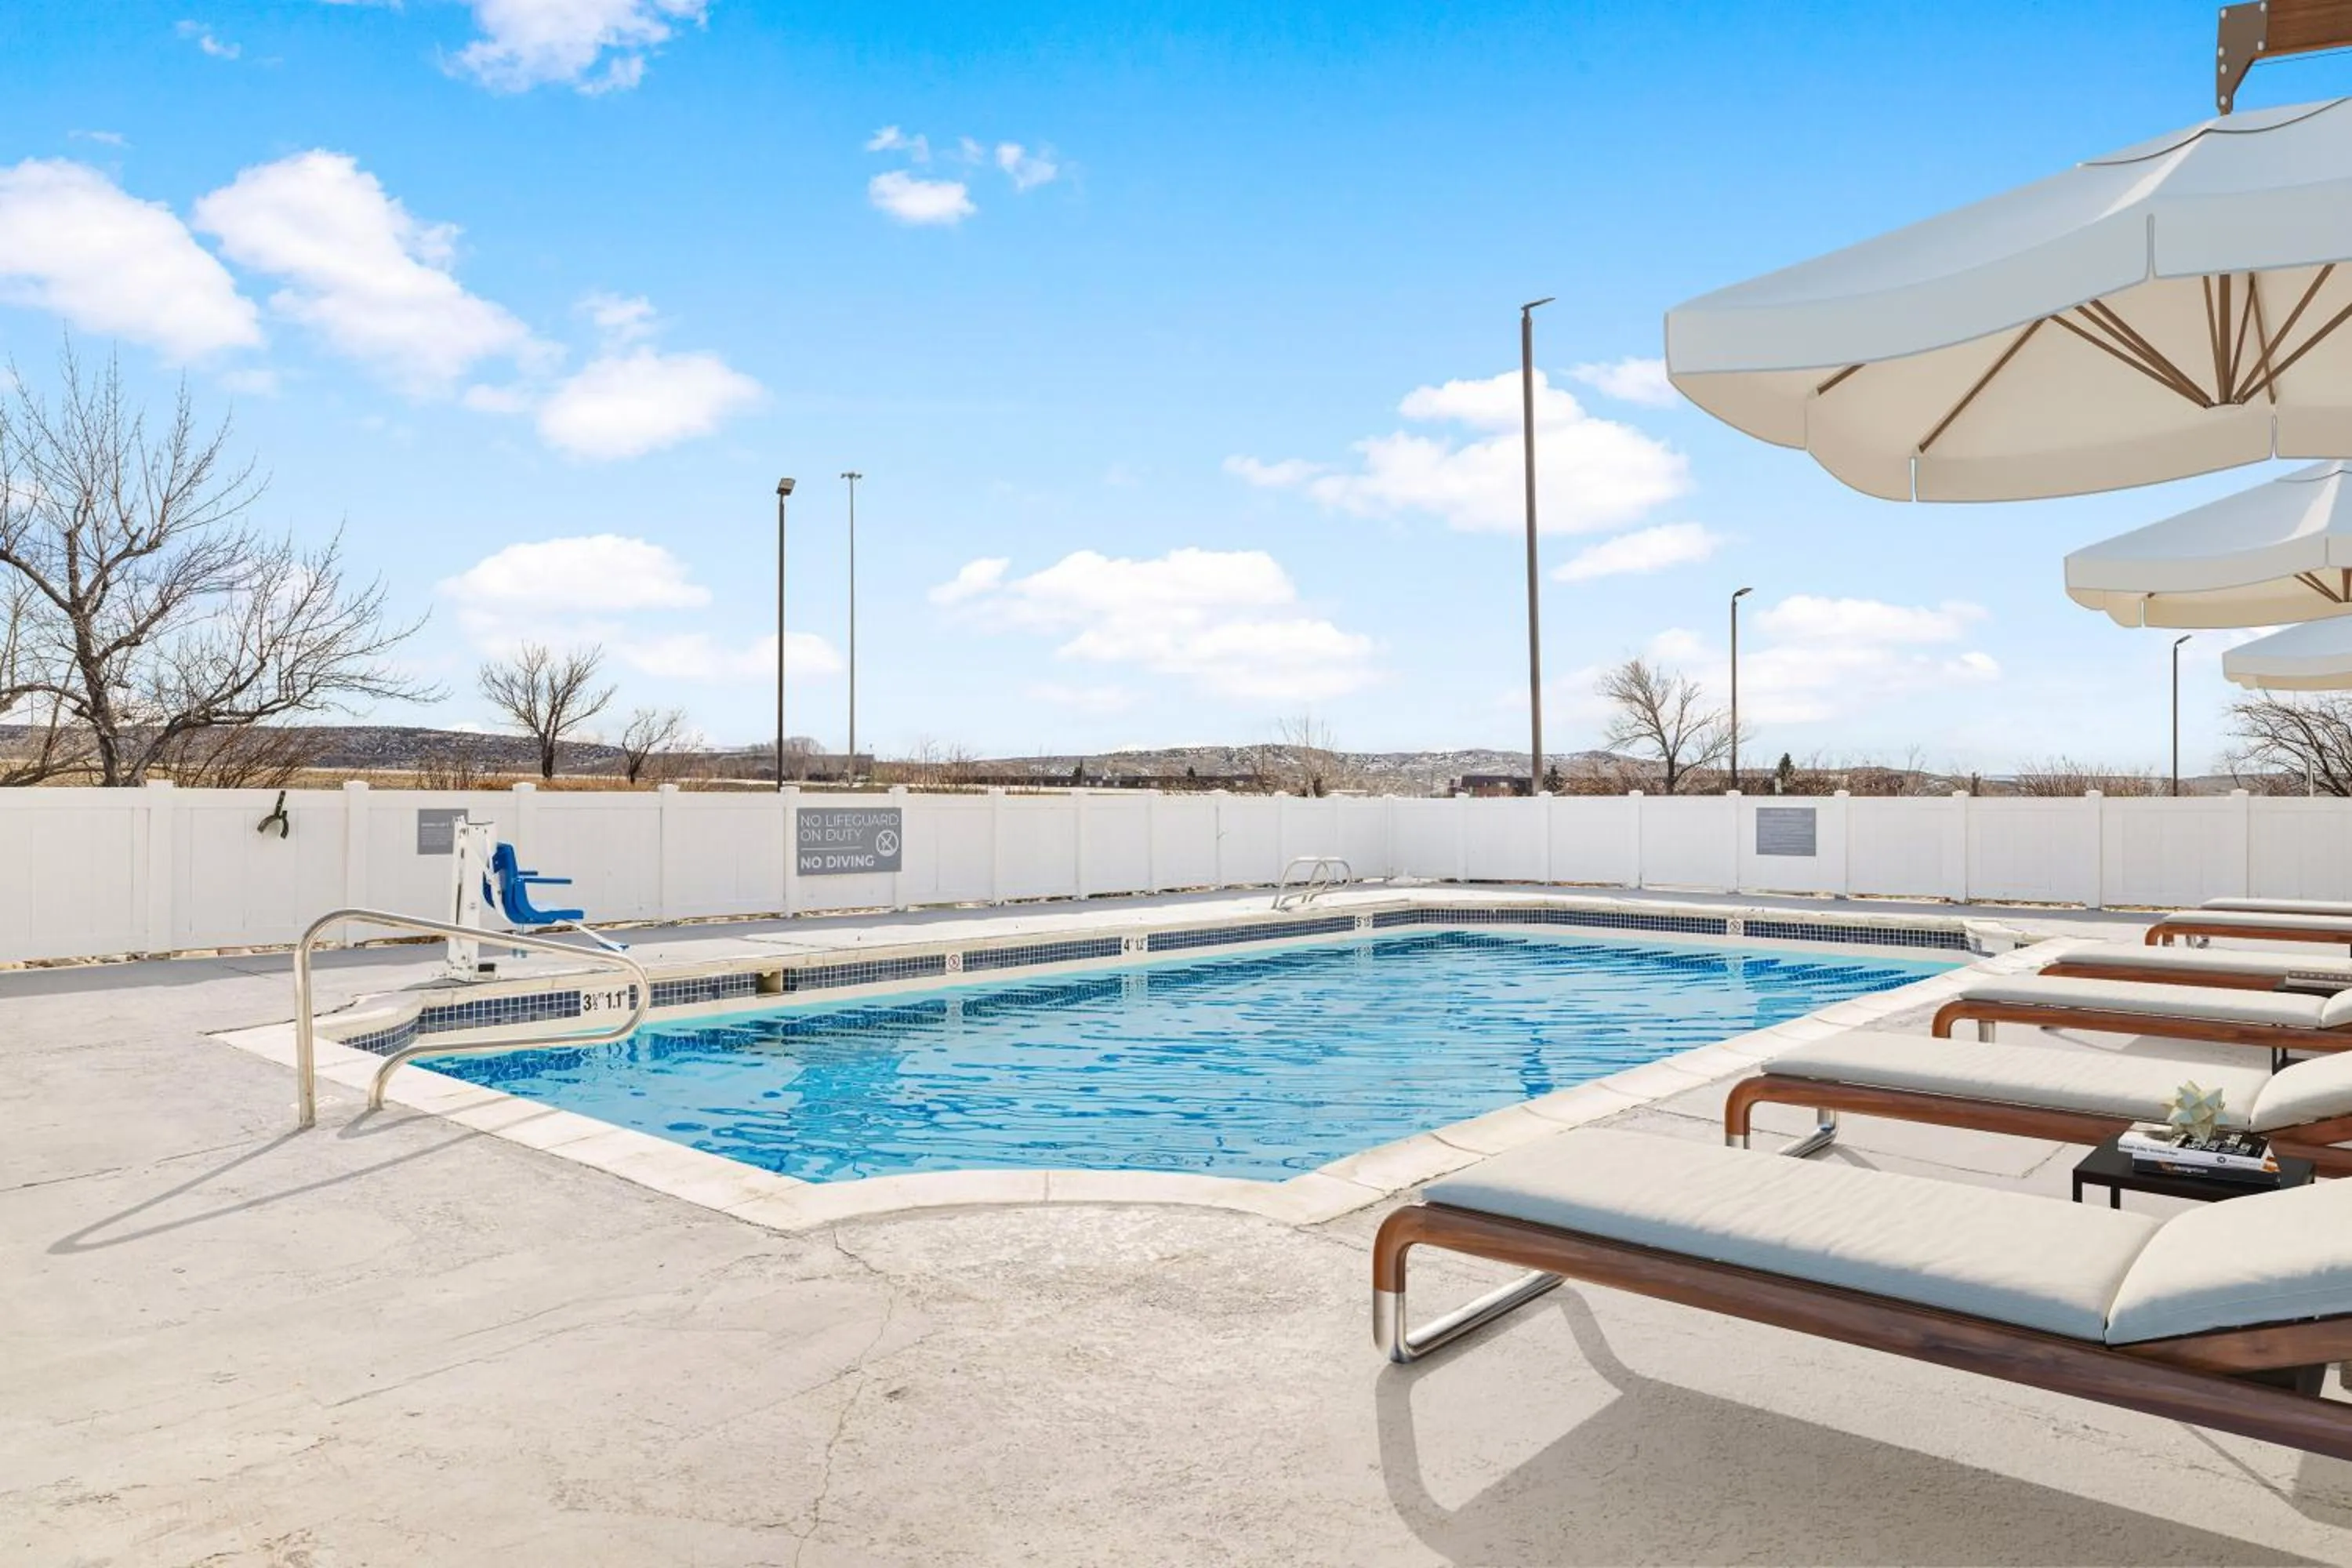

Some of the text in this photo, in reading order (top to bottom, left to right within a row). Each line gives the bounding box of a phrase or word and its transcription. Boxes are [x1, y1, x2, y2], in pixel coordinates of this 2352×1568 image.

[800, 813, 899, 828] NO LIFEGUARD
[800, 828, 863, 842] ON DUTY
[800, 855, 875, 869] NO DIVING
